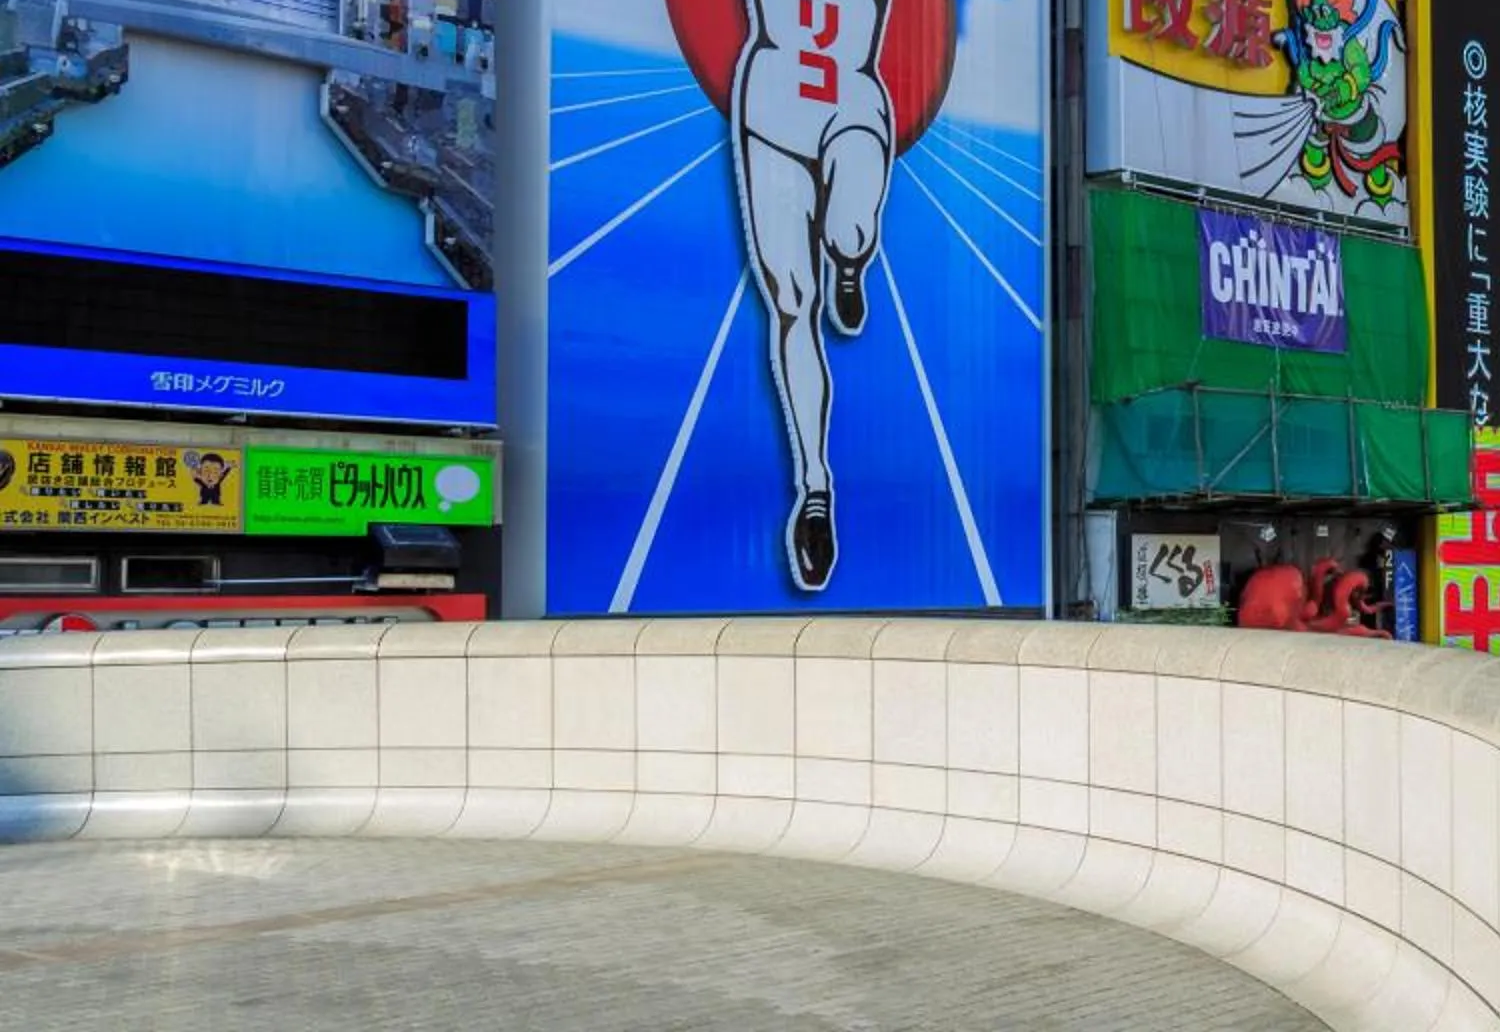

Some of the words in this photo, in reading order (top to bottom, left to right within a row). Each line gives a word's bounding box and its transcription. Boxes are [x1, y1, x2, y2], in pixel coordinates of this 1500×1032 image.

[150, 371, 286, 398] 雪印メグミルク
[28, 452, 178, 478] 店舗情報館
[329, 461, 426, 509] ピタットハウス
[58, 512, 150, 526] 関西インベスト
